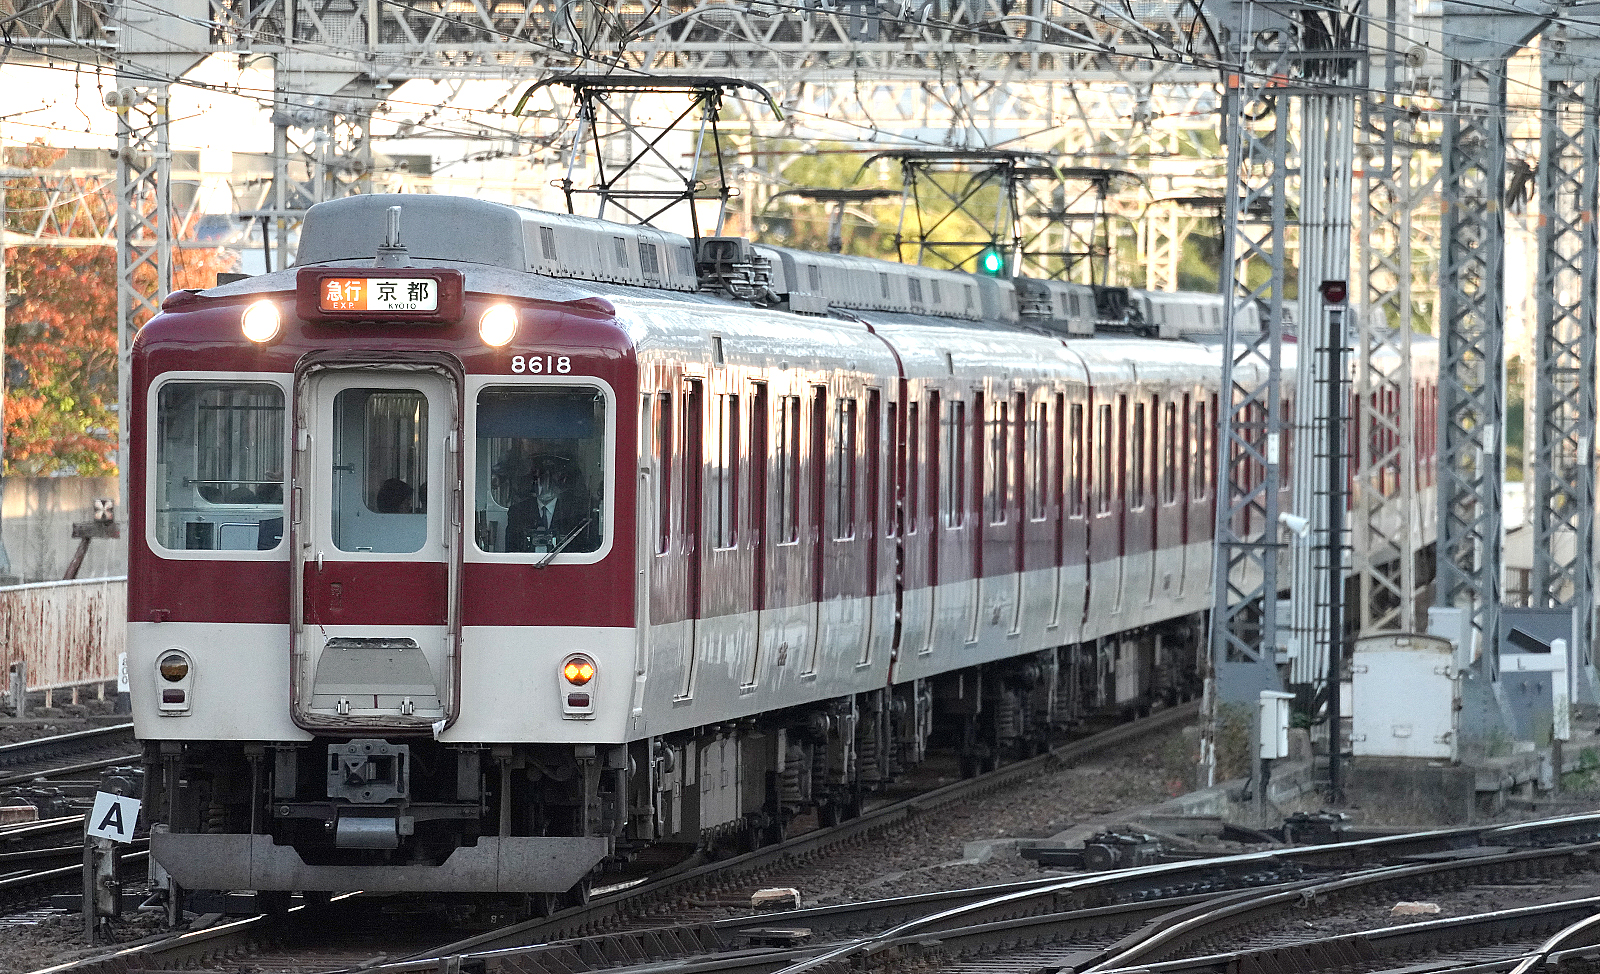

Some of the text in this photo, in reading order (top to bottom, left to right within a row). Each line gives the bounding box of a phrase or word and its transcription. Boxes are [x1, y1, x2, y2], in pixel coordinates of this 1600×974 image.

[326, 280, 361, 302] 急行
[376, 281, 429, 302] 京都
[511, 355, 571, 374] 8618
[97, 802, 124, 835] A
